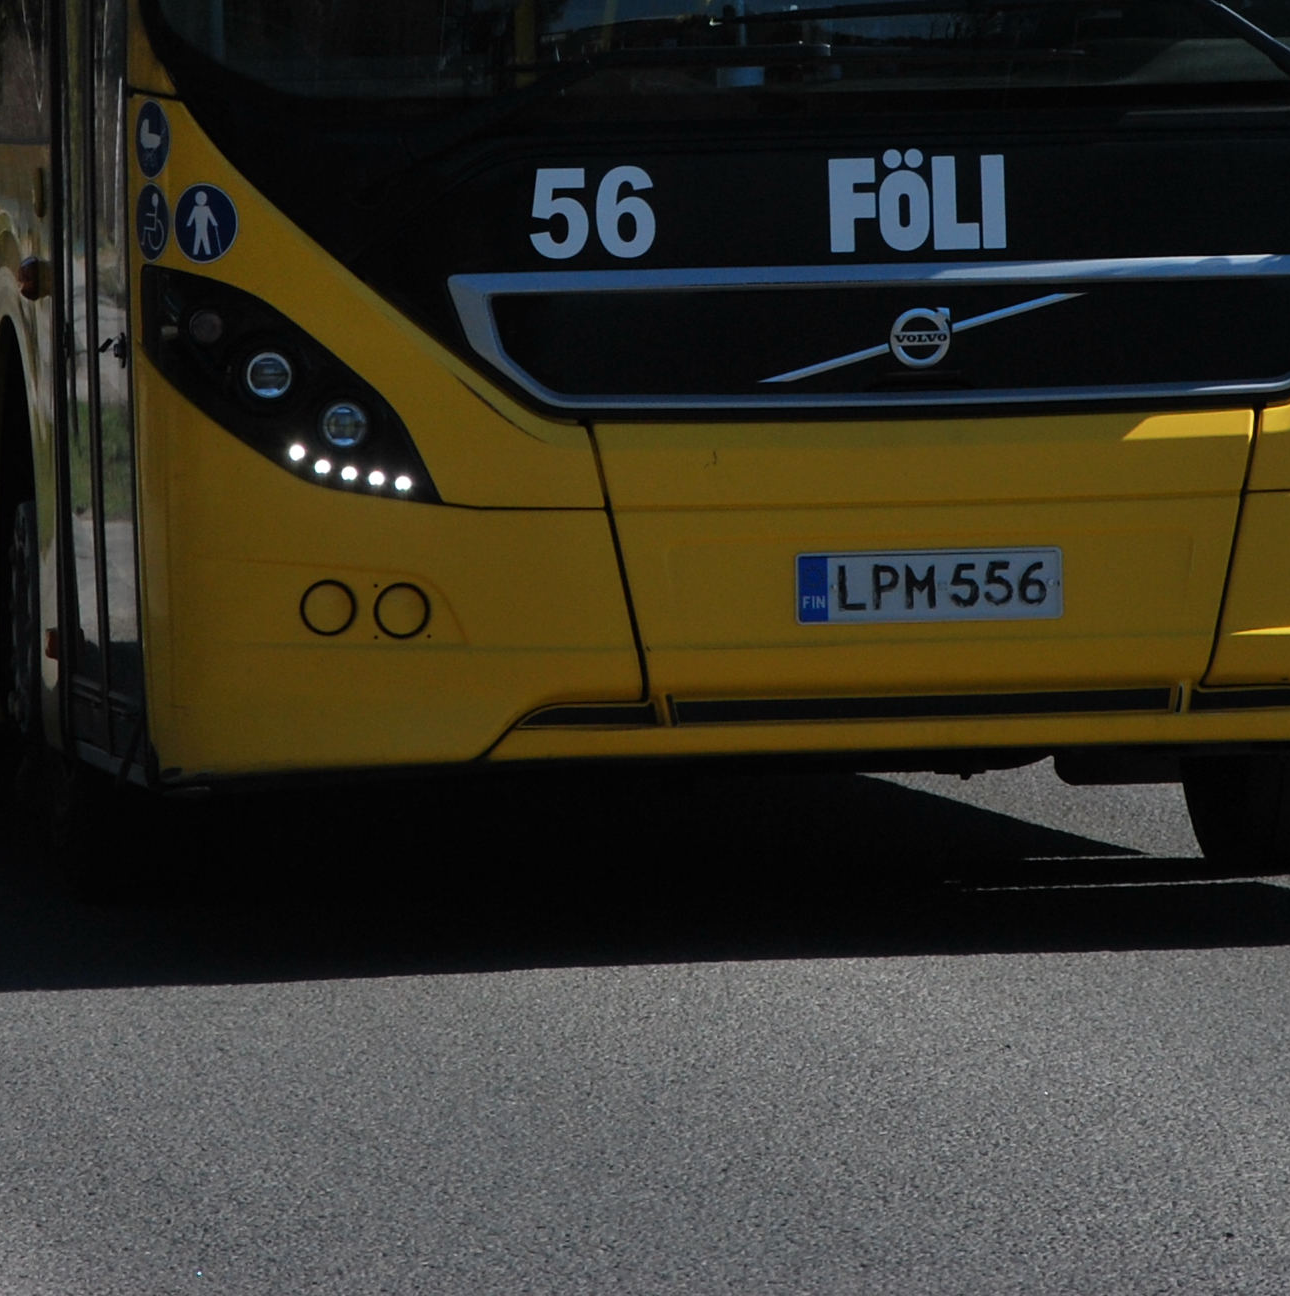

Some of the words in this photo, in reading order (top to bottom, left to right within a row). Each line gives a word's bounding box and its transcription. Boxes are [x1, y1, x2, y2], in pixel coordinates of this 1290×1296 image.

[529, 165, 657, 260] 56
[827, 147, 1007, 254] FÖLI
[894, 333, 948, 344] VOLVO
[802, 595, 826, 609] FIN
